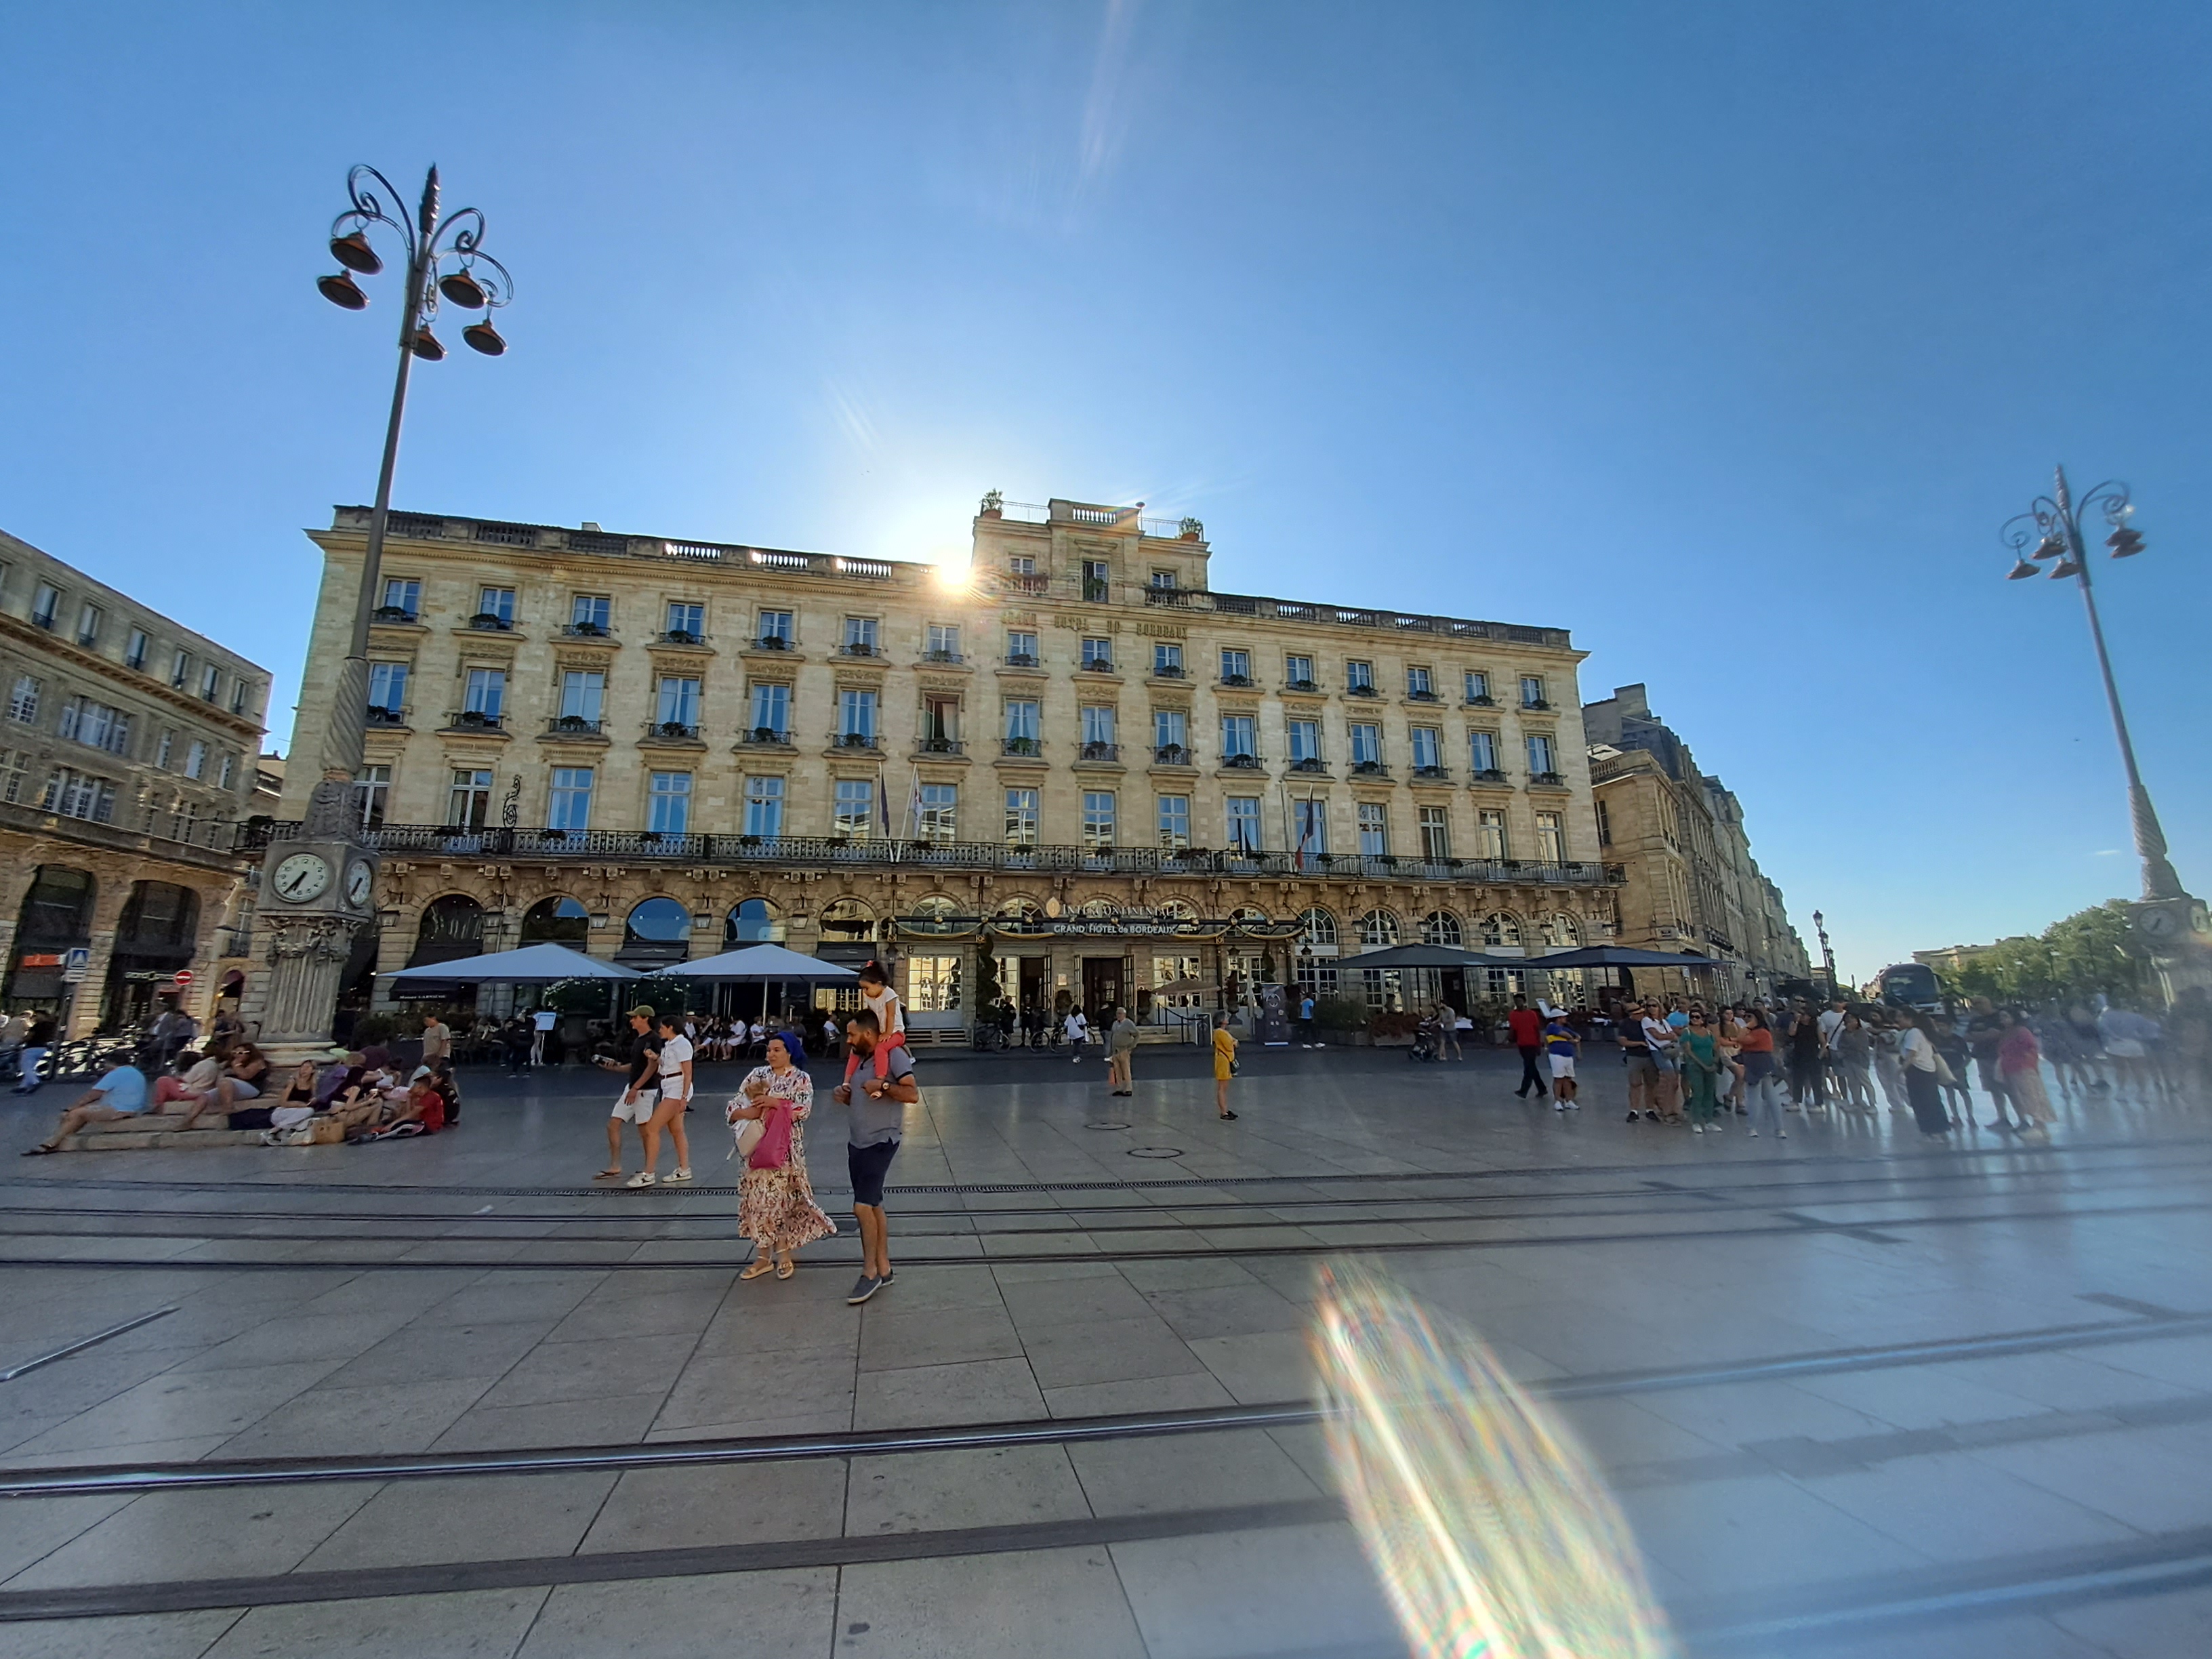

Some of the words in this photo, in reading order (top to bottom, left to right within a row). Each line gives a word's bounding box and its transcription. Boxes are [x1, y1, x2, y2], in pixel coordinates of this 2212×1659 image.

[1136, 623, 1187, 639] BORDEAUX
[1054, 924, 1085, 933] GRAND
[1118, 925, 1128, 933] de
[1130, 926, 1175, 934] BORDEAUX
